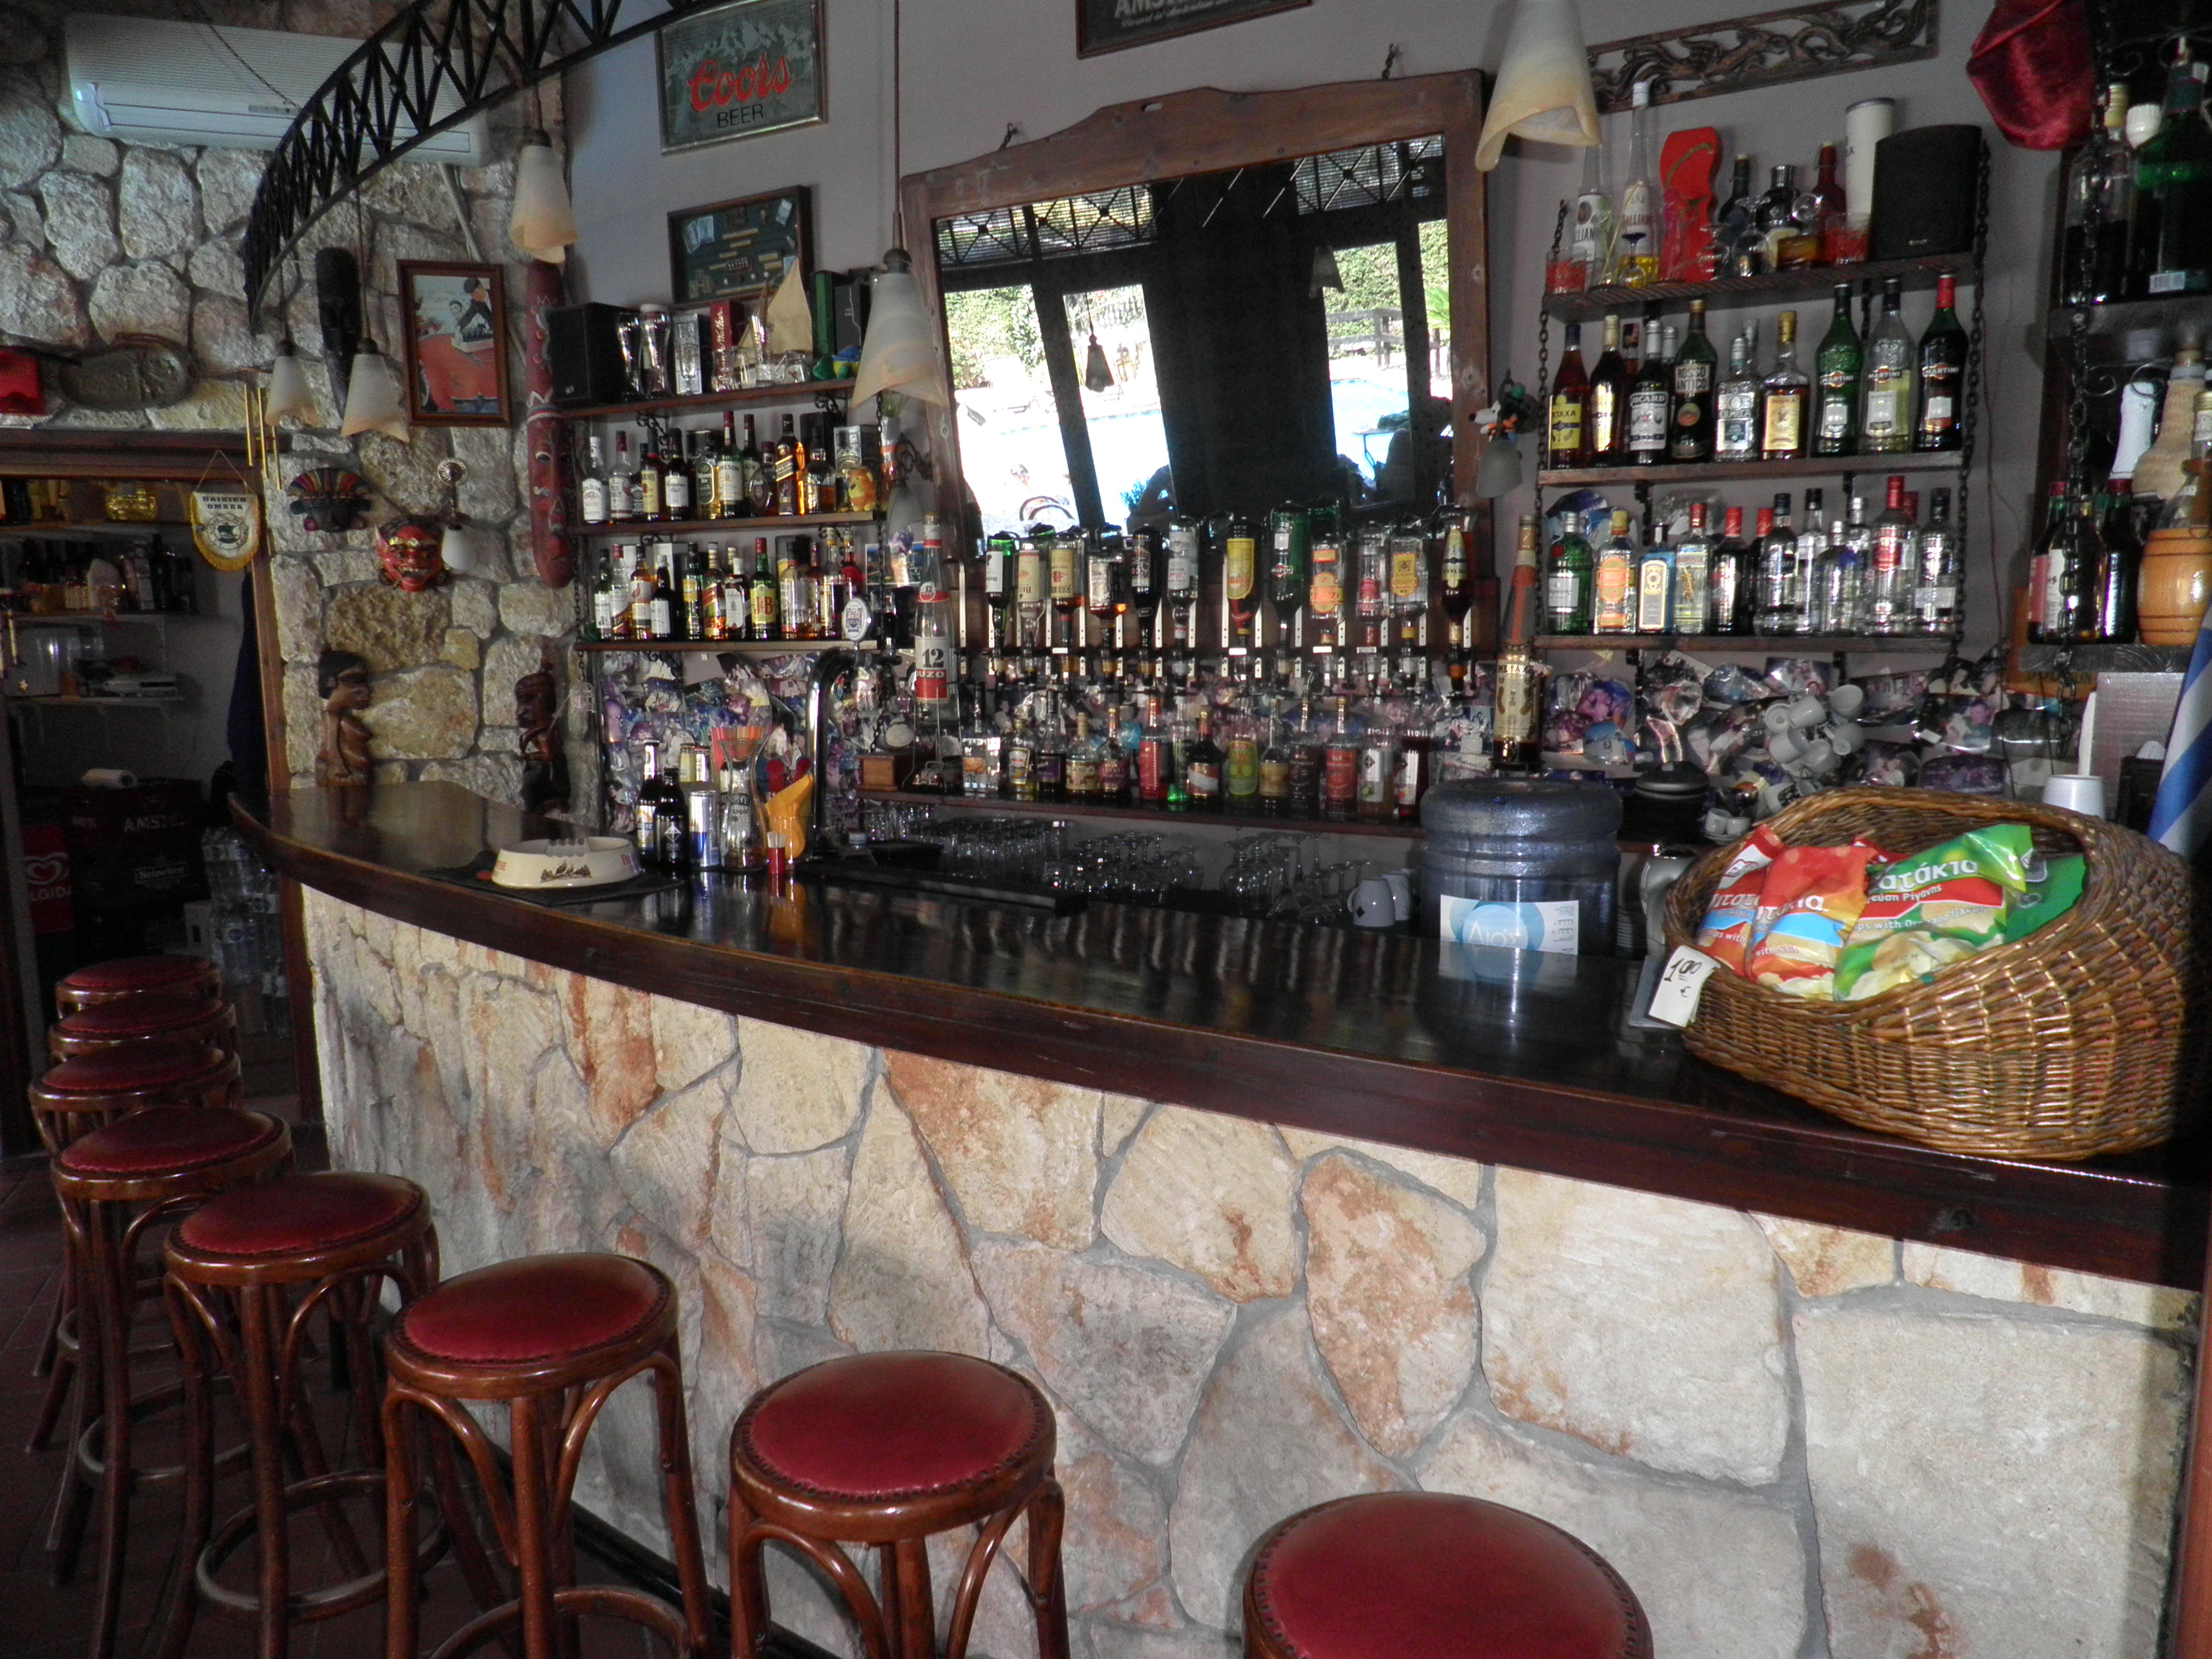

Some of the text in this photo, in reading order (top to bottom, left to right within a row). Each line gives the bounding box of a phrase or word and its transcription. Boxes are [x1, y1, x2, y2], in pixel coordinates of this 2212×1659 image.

[687, 54, 792, 111] Coors
[717, 103, 764, 129] BEER
[1677, 367, 1706, 379] ROSSO
[1868, 371, 1900, 380] MARTINI
[754, 596, 773, 615] J&B
[923, 648, 944, 668] 12
[1874, 920, 1901, 929] with
[1725, 933, 1745, 943] with
